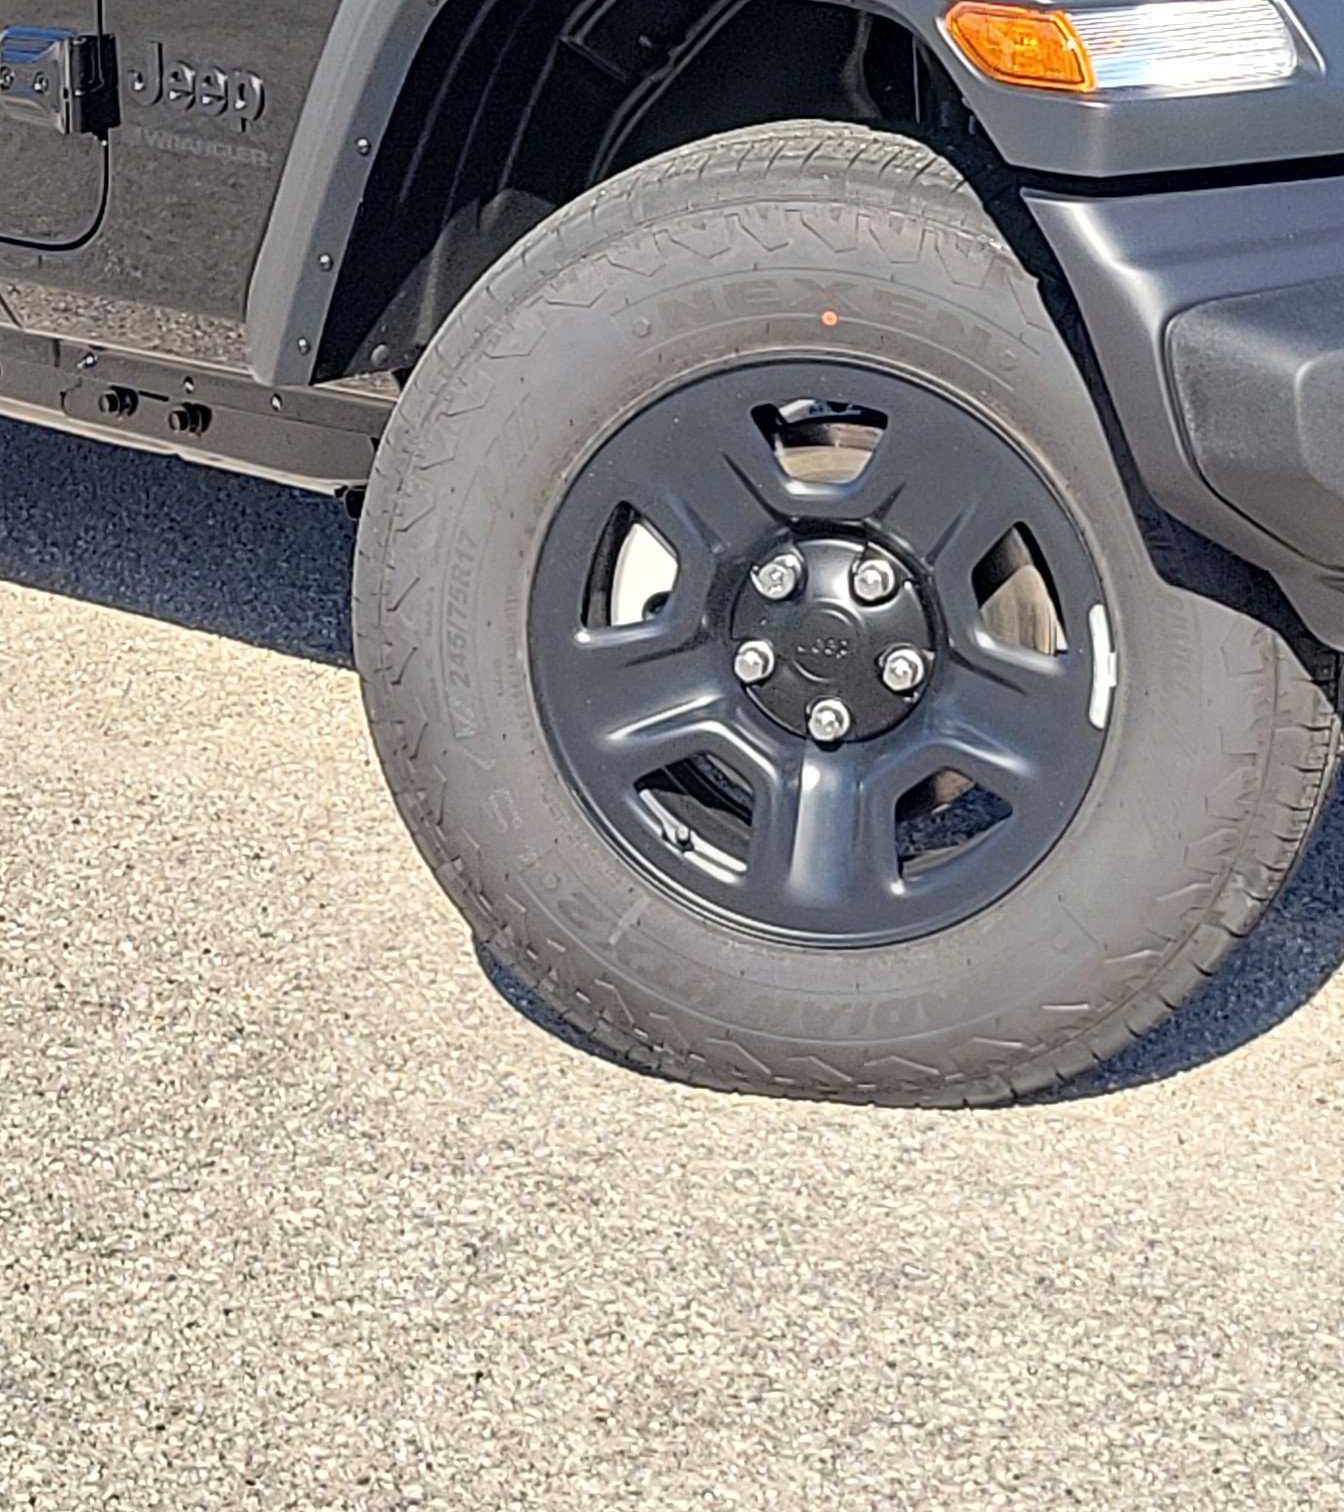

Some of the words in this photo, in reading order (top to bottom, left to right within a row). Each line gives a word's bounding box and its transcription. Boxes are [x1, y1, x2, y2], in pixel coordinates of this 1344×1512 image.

[127, 40, 265, 133] Jeep
[656, 275, 992, 356] NEXEN
[446, 526, 478, 689] 245/75R17
